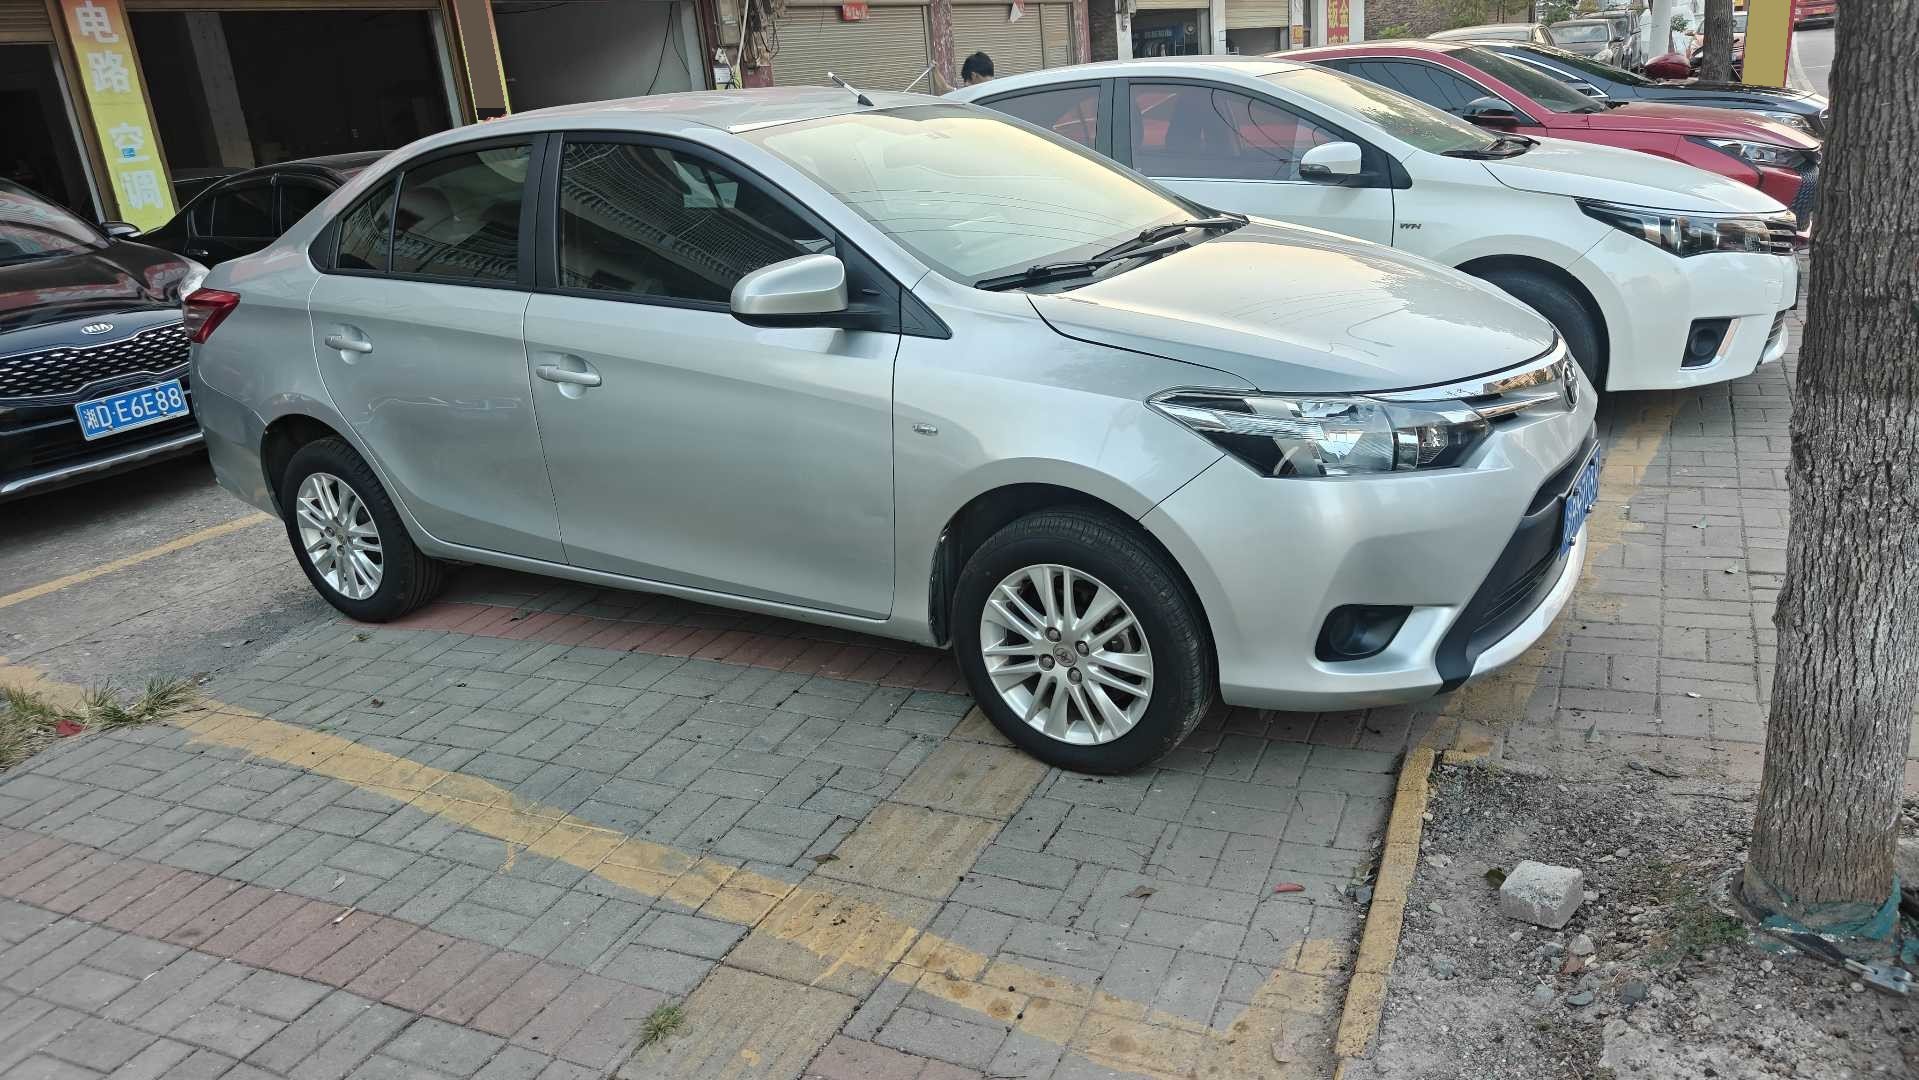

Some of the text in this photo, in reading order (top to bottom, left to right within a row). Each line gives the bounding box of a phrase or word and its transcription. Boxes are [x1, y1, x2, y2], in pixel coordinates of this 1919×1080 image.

[75, 0, 164, 210] 电路 空调
[84, 322, 111, 333] KIA
